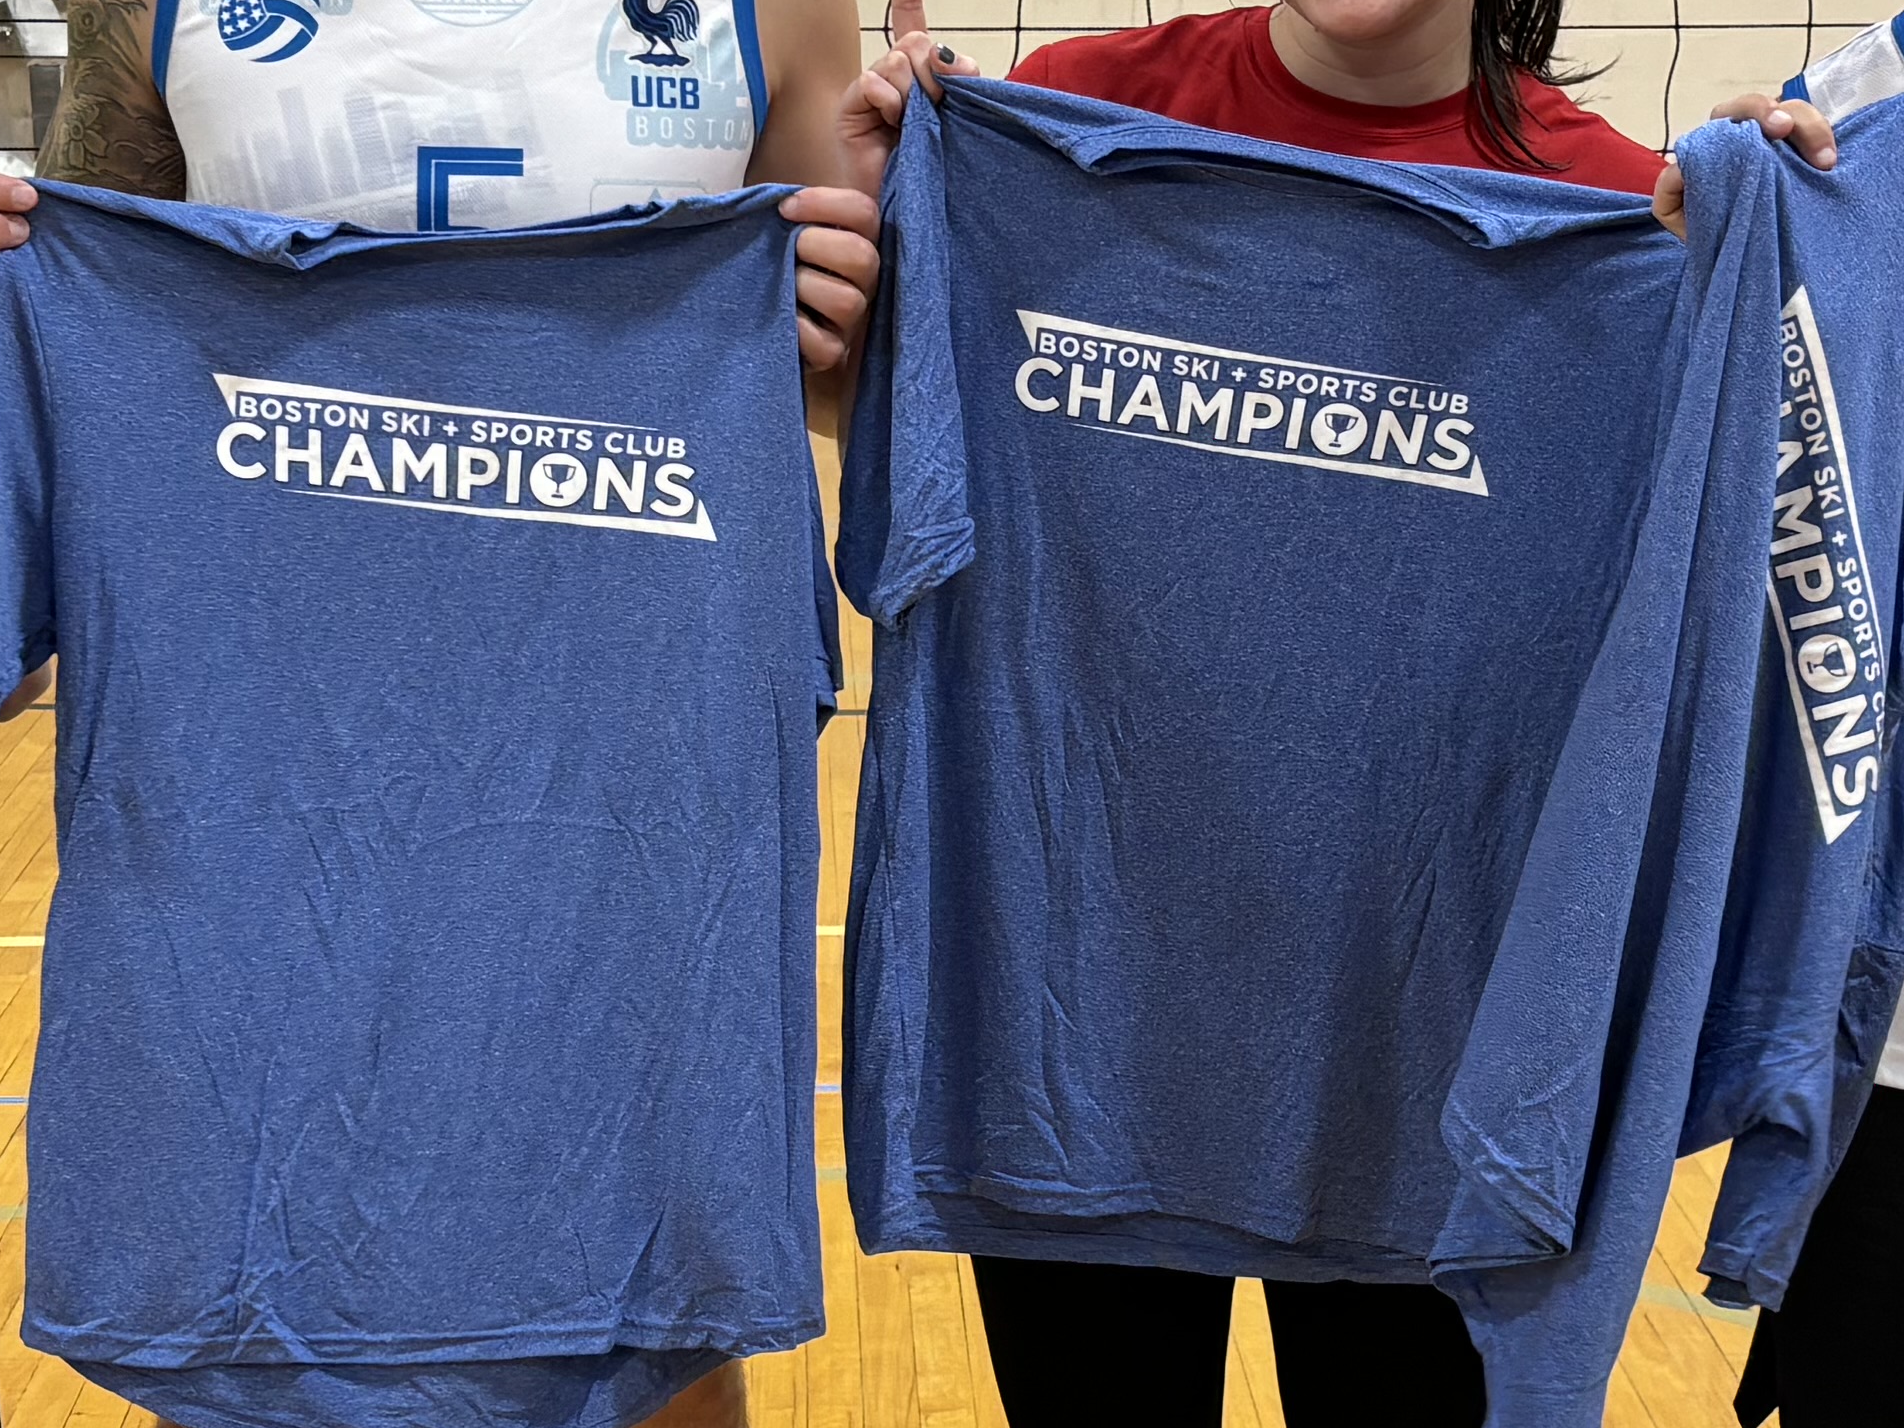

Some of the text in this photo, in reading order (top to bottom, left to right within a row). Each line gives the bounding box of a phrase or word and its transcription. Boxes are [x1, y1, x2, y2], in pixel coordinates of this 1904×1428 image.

[631, 75, 700, 110] UCB
[635, 115, 752, 142] BOSTON
[1014, 358, 1475, 472] CHAMPIONS
[1039, 332, 1162, 372] BOSTON
[1172, 357, 1219, 382] SKI
[1258, 368, 1377, 403] SPORTS
[1388, 386, 1470, 415] CLUB
[239, 395, 369, 430] BOSTON
[382, 410, 429, 436] SKI
[471, 421, 594, 452] SPORTS
[604, 432, 686, 459] CLUB
[216, 421, 696, 518] CHAMPIONS
[1779, 320, 1828, 456] BOSTON
[1814, 463, 1845, 520] SKI
[1837, 556, 1881, 682] SPORTS
